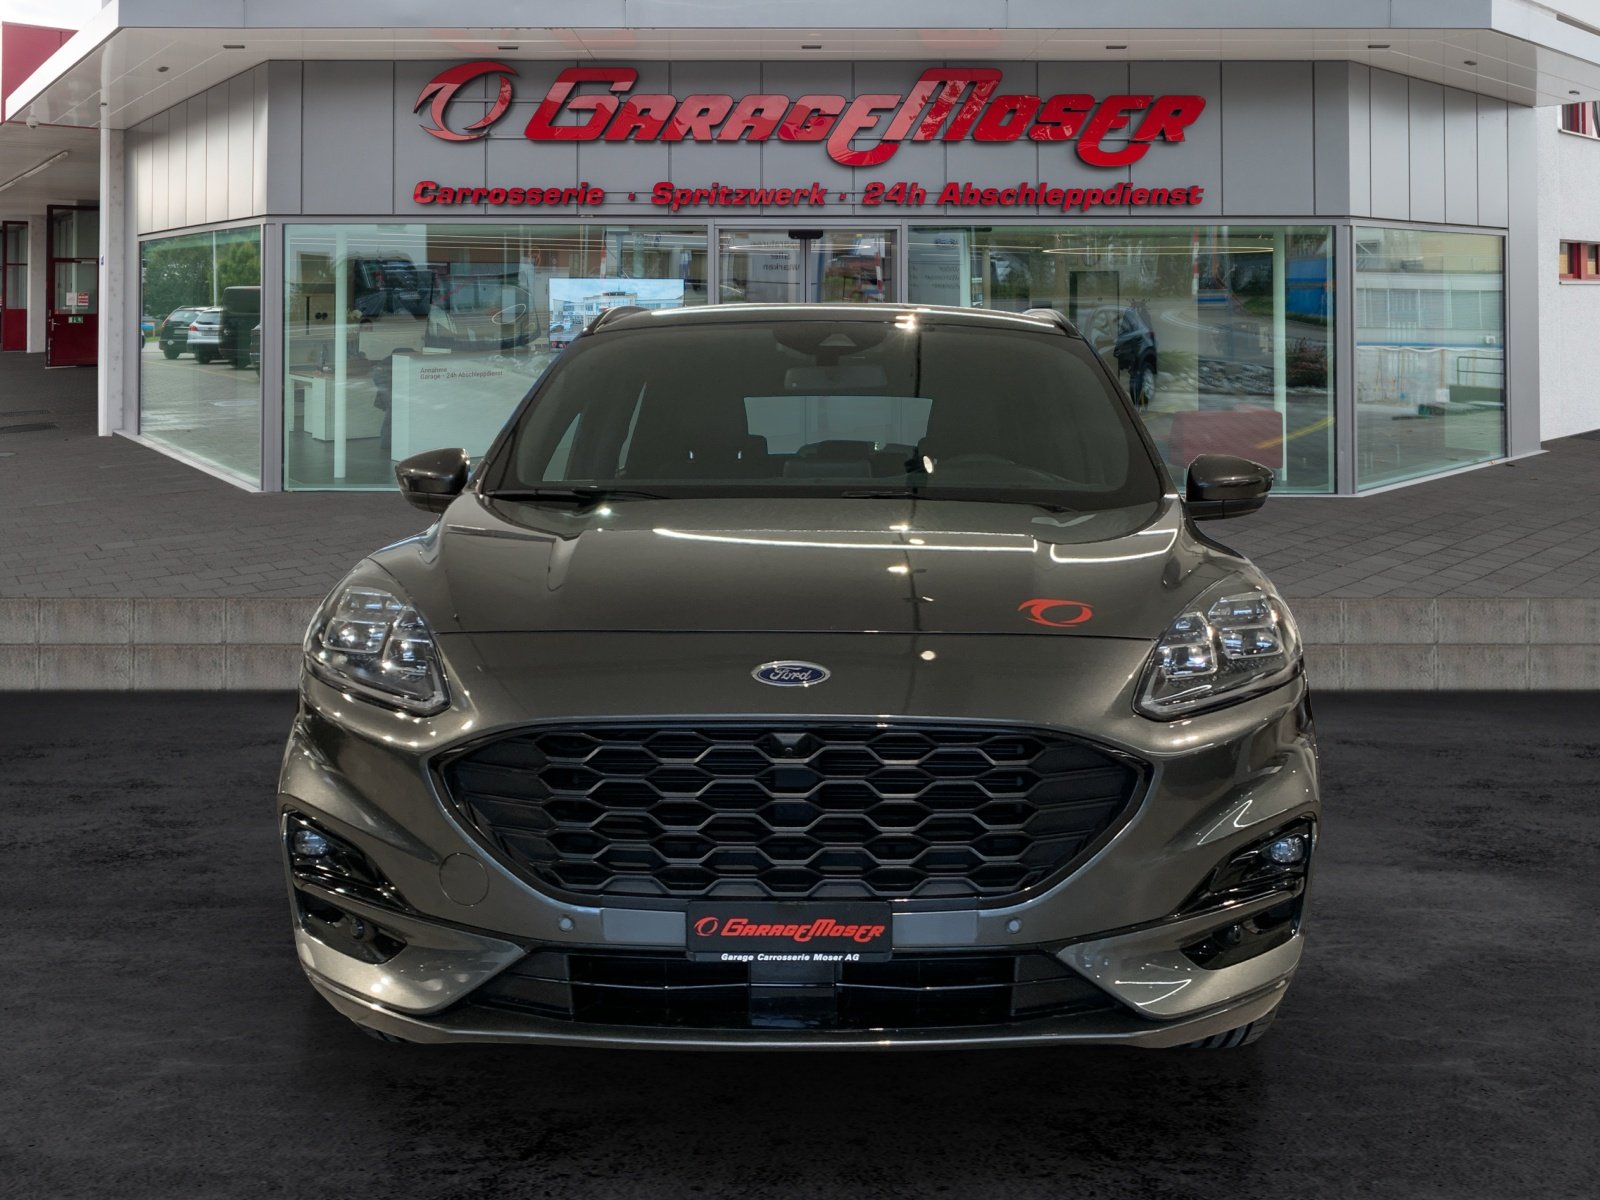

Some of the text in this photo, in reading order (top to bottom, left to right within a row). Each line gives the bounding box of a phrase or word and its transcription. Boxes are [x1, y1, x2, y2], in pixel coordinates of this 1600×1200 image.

[413, 181, 1204, 211] Carrosserie Spritzwerk 24h Abschleppdienst
[458, 370, 503, 379] Abschleppdienst
[769, 666, 812, 681] Ford
[720, 953, 860, 962] Garage Carrosserie Moser AG
